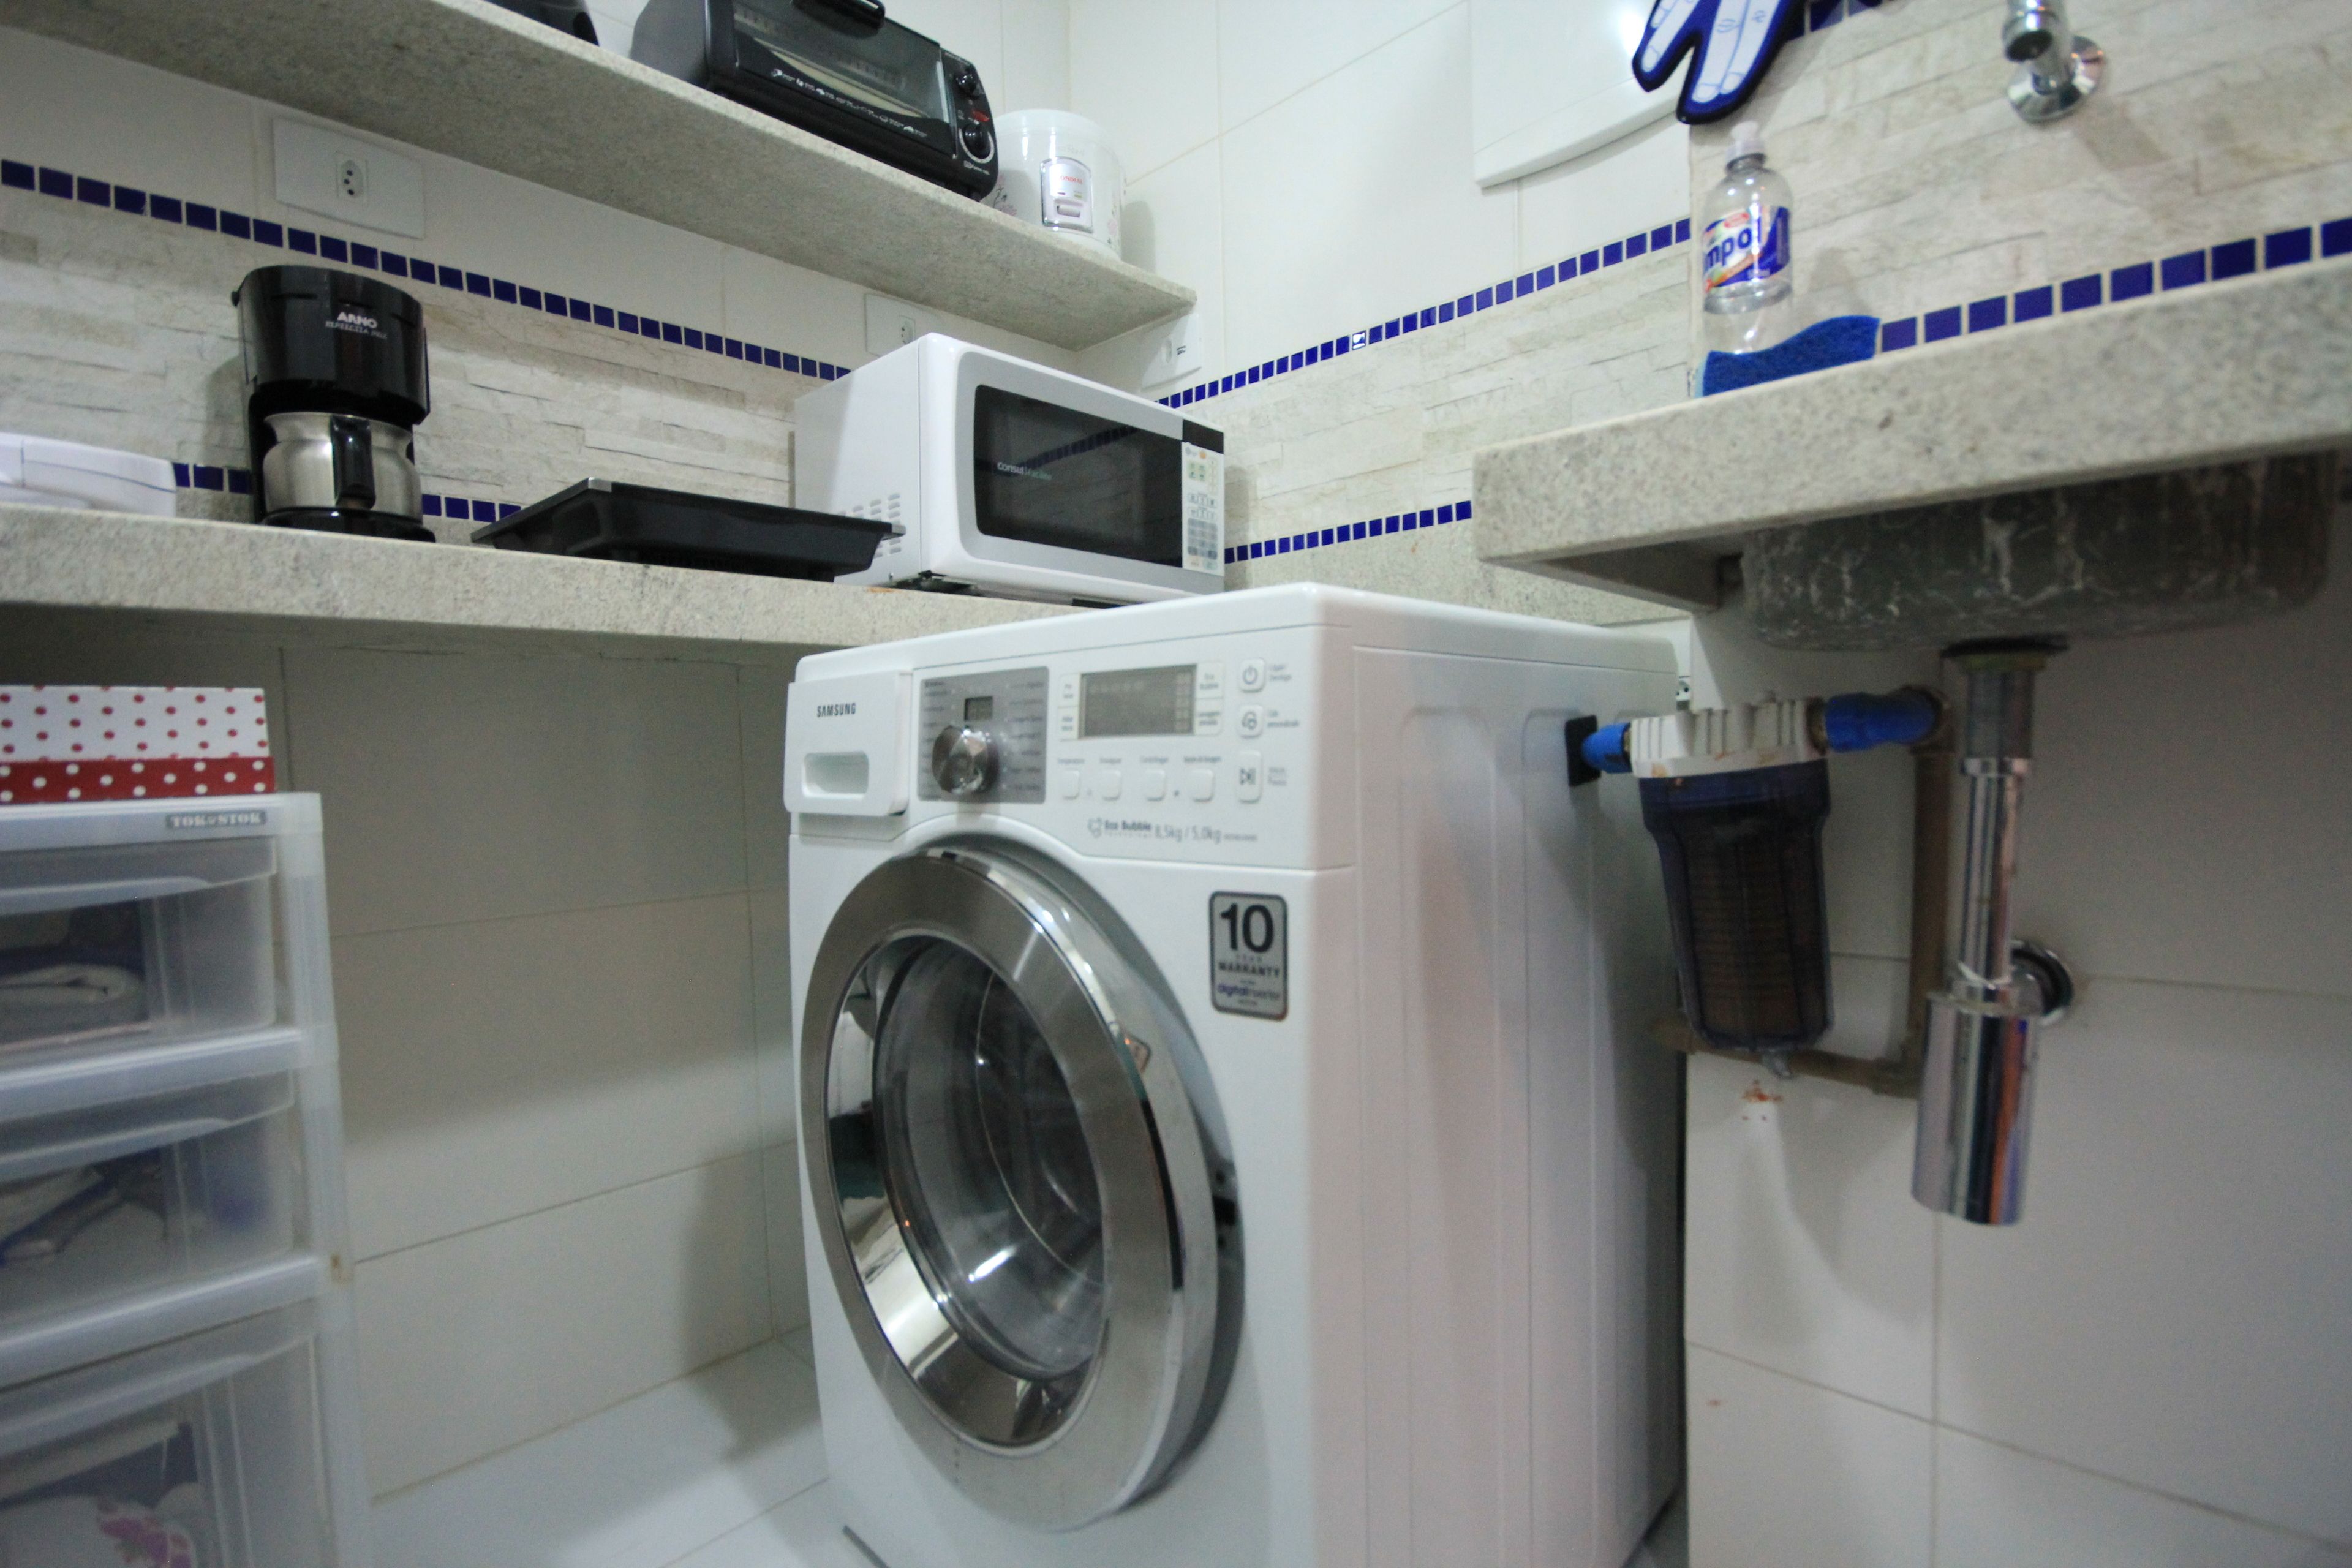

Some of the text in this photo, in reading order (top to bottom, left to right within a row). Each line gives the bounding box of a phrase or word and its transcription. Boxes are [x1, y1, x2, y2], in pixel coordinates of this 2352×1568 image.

[337, 311, 378, 329] ARNO
[816, 702, 856, 718] SAMSUNG
[1121, 819, 1152, 831] Bubble
[1219, 902, 1275, 953] 10
[1219, 961, 1280, 977] WARRANTY
